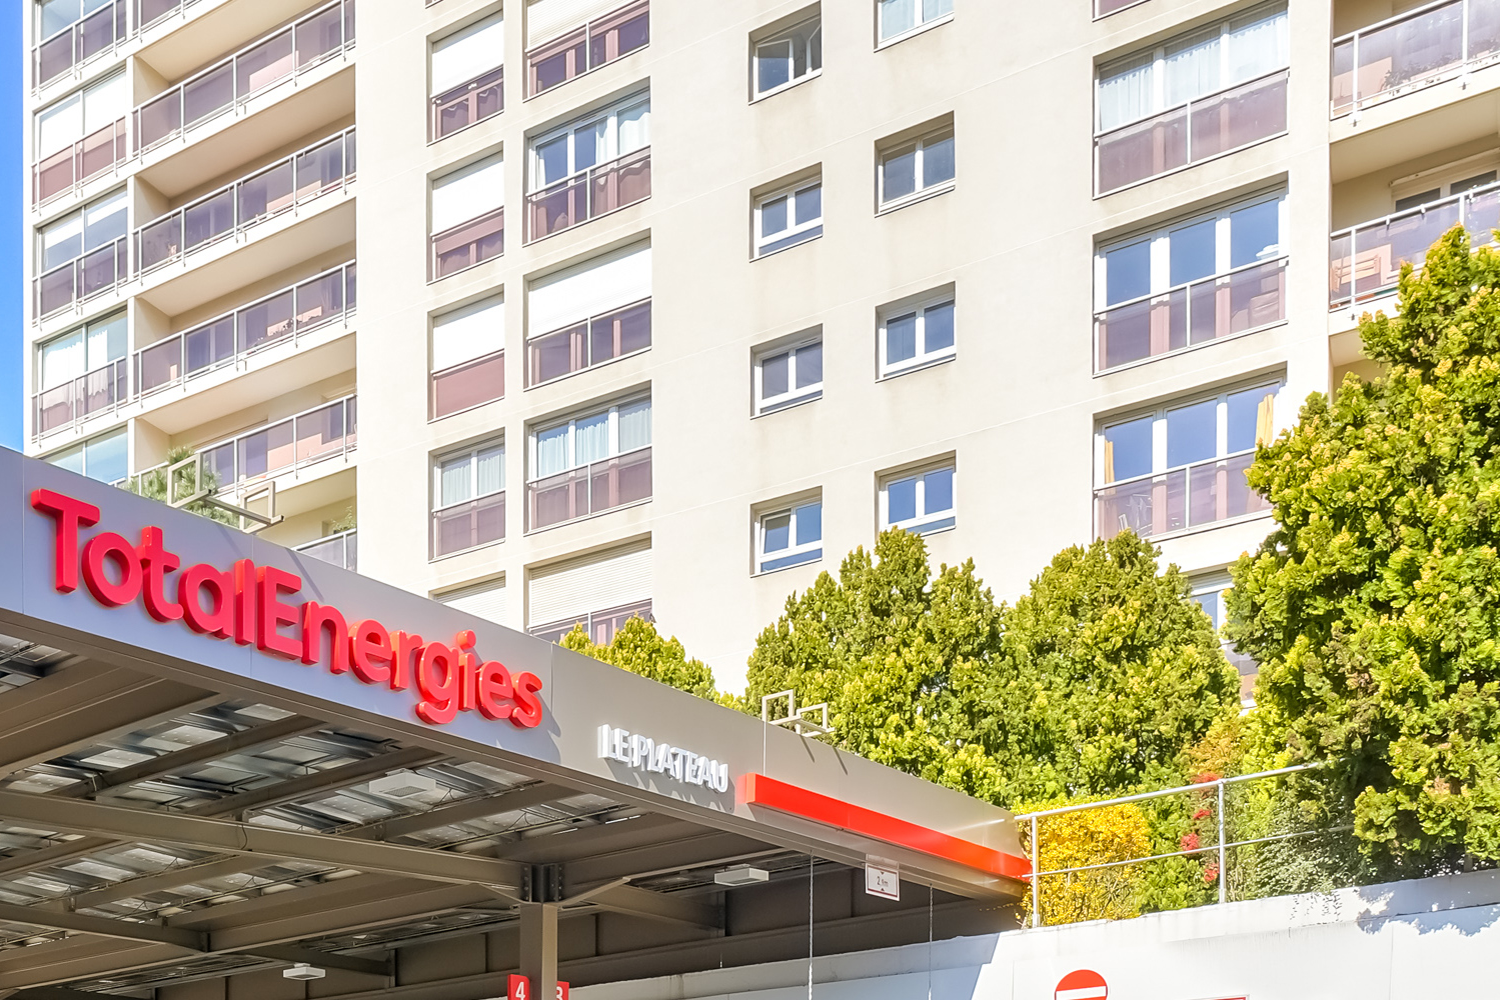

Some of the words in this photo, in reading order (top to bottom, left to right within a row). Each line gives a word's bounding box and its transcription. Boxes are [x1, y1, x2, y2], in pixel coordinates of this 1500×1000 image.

[30, 488, 543, 729] TotalEnergies
[598, 724, 629, 763] LE
[631, 734, 728, 793] PLATEAU
